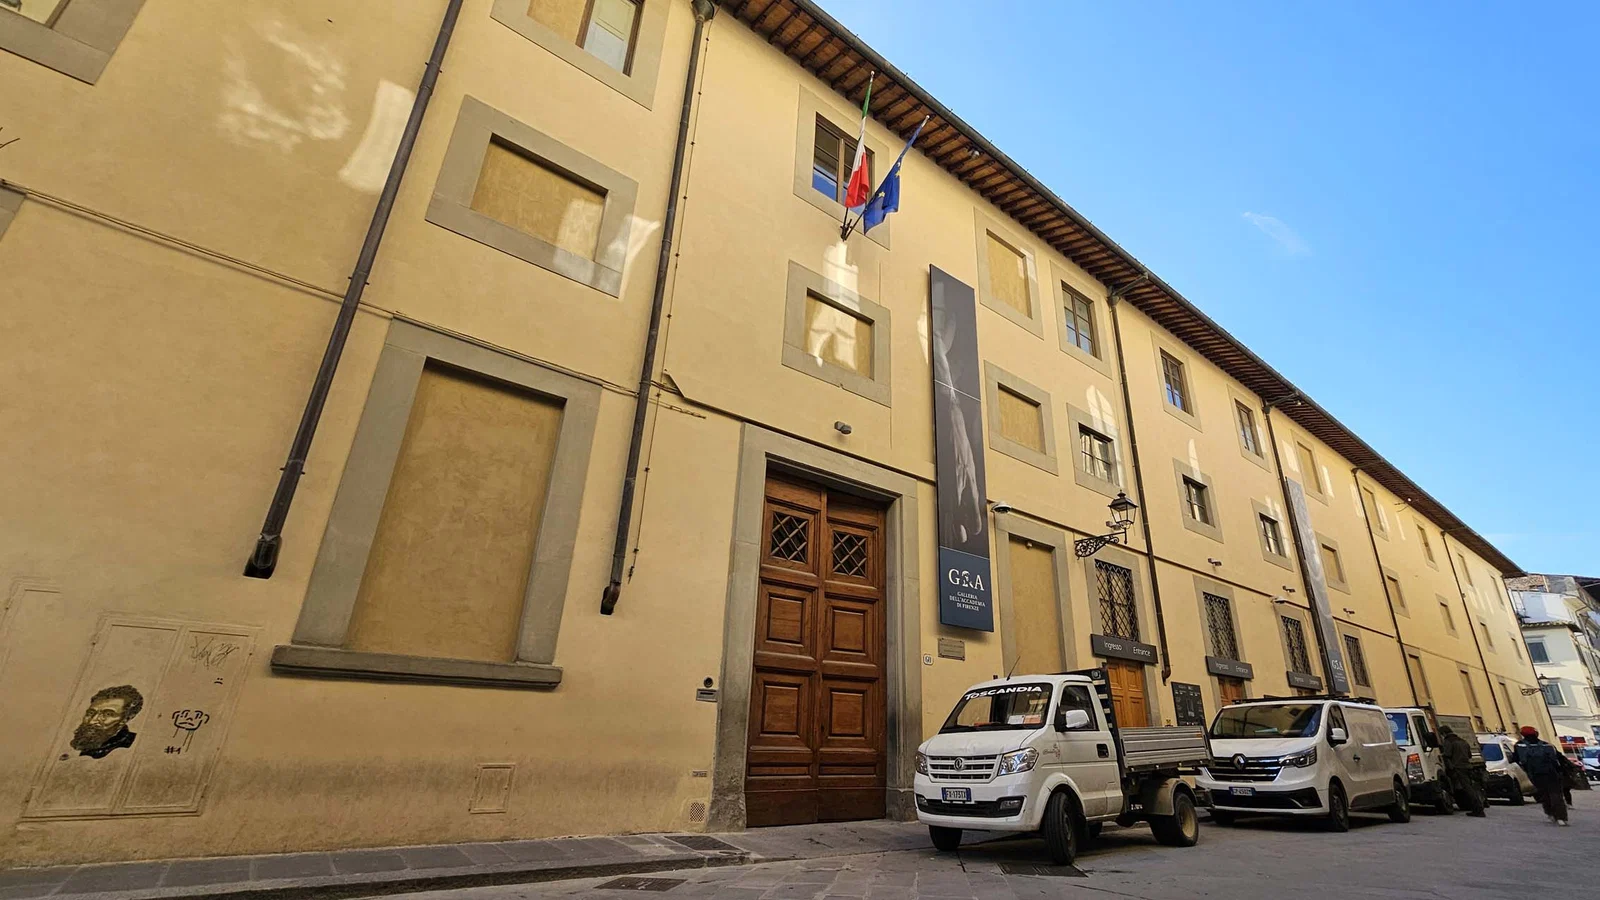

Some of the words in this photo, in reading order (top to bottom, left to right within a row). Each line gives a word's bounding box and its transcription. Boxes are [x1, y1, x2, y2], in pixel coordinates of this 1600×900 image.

[949, 595, 986, 607] DELL'ACCADEMIA
[957, 591, 978, 600] GALLERIA
[1103, 640, 1123, 651] Ingresso
[1132, 646, 1151, 657] Entrance
[964, 686, 1043, 701] TOSCANDIA
